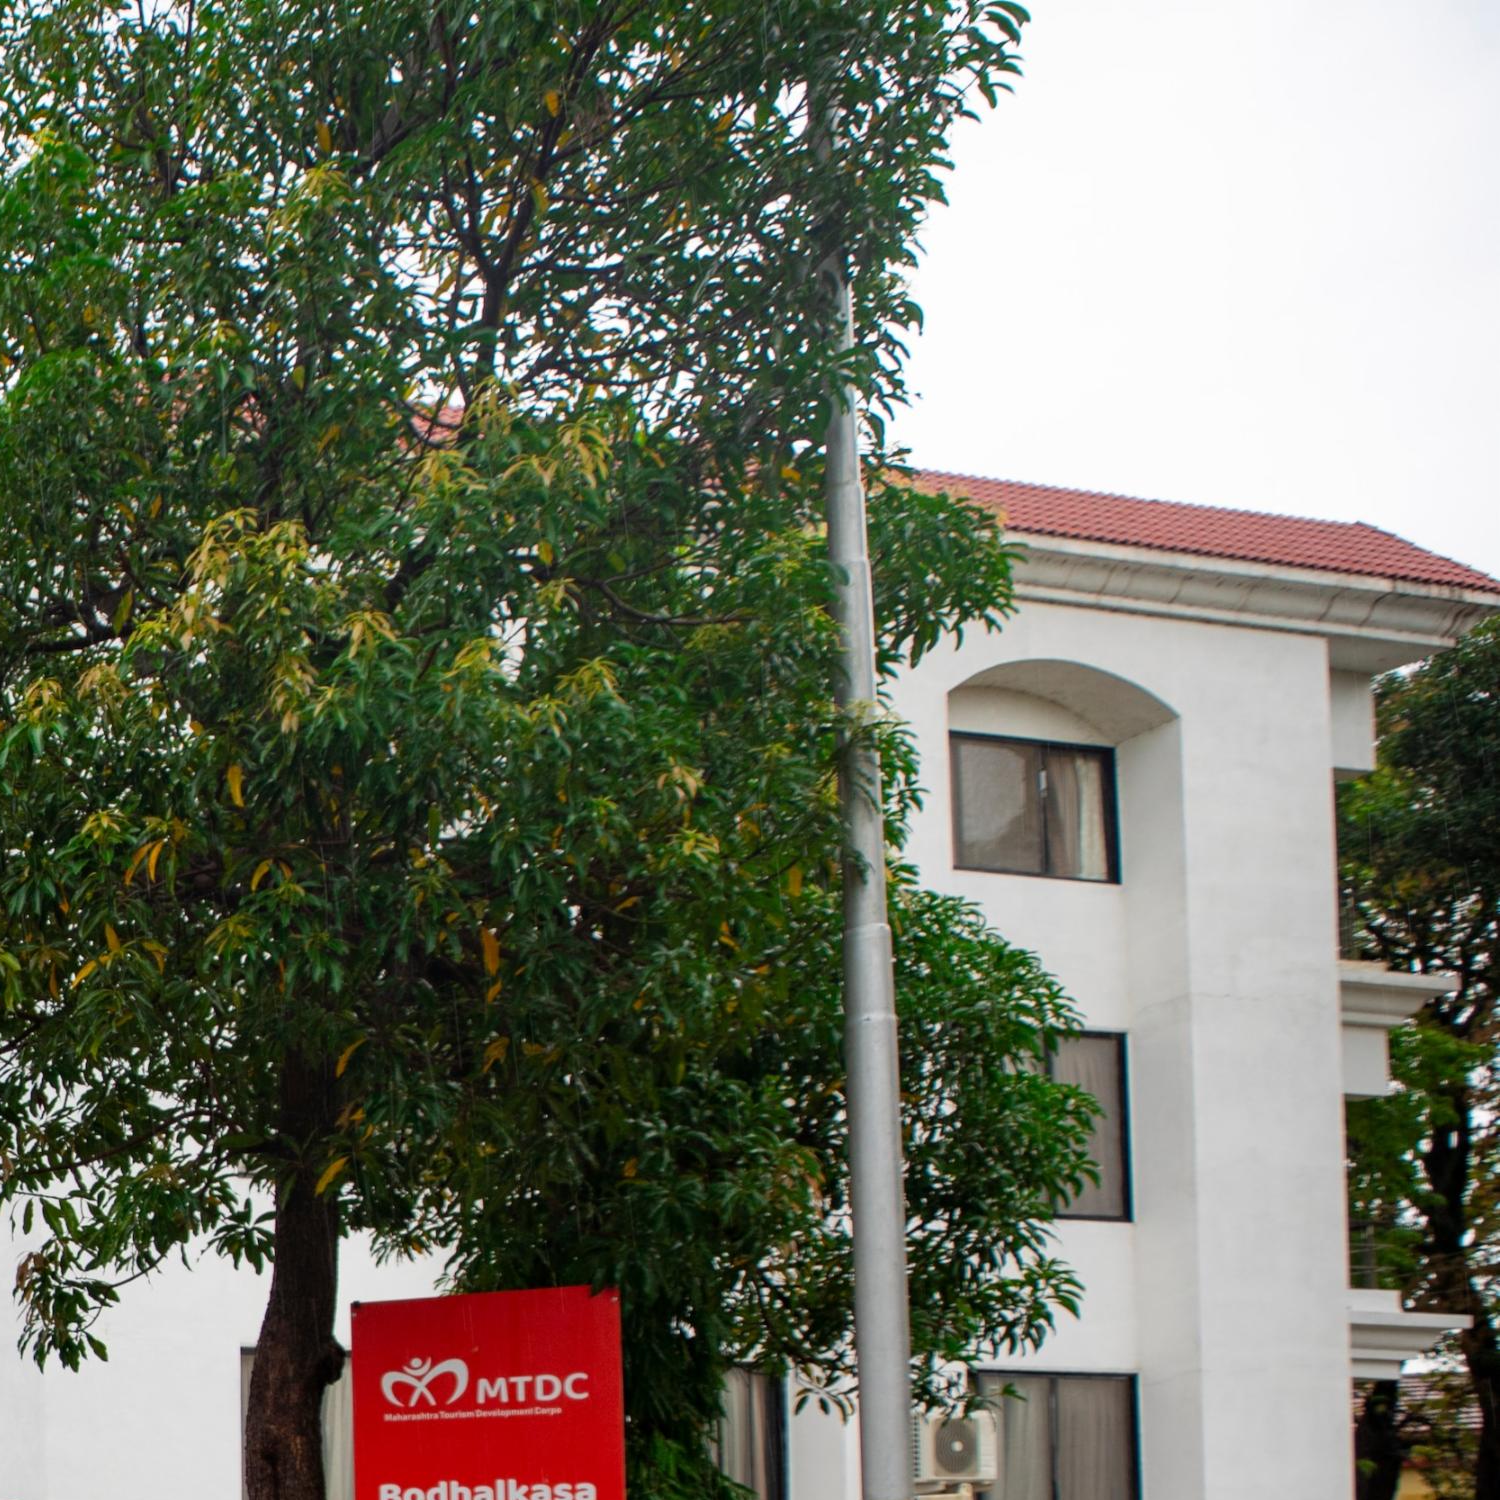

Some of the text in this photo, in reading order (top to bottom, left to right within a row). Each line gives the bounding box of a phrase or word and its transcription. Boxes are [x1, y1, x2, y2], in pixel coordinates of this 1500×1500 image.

[476, 1372, 590, 1405] MTDC
[383, 1406, 562, 1421] Maharashtra Tourism Development Corpo
